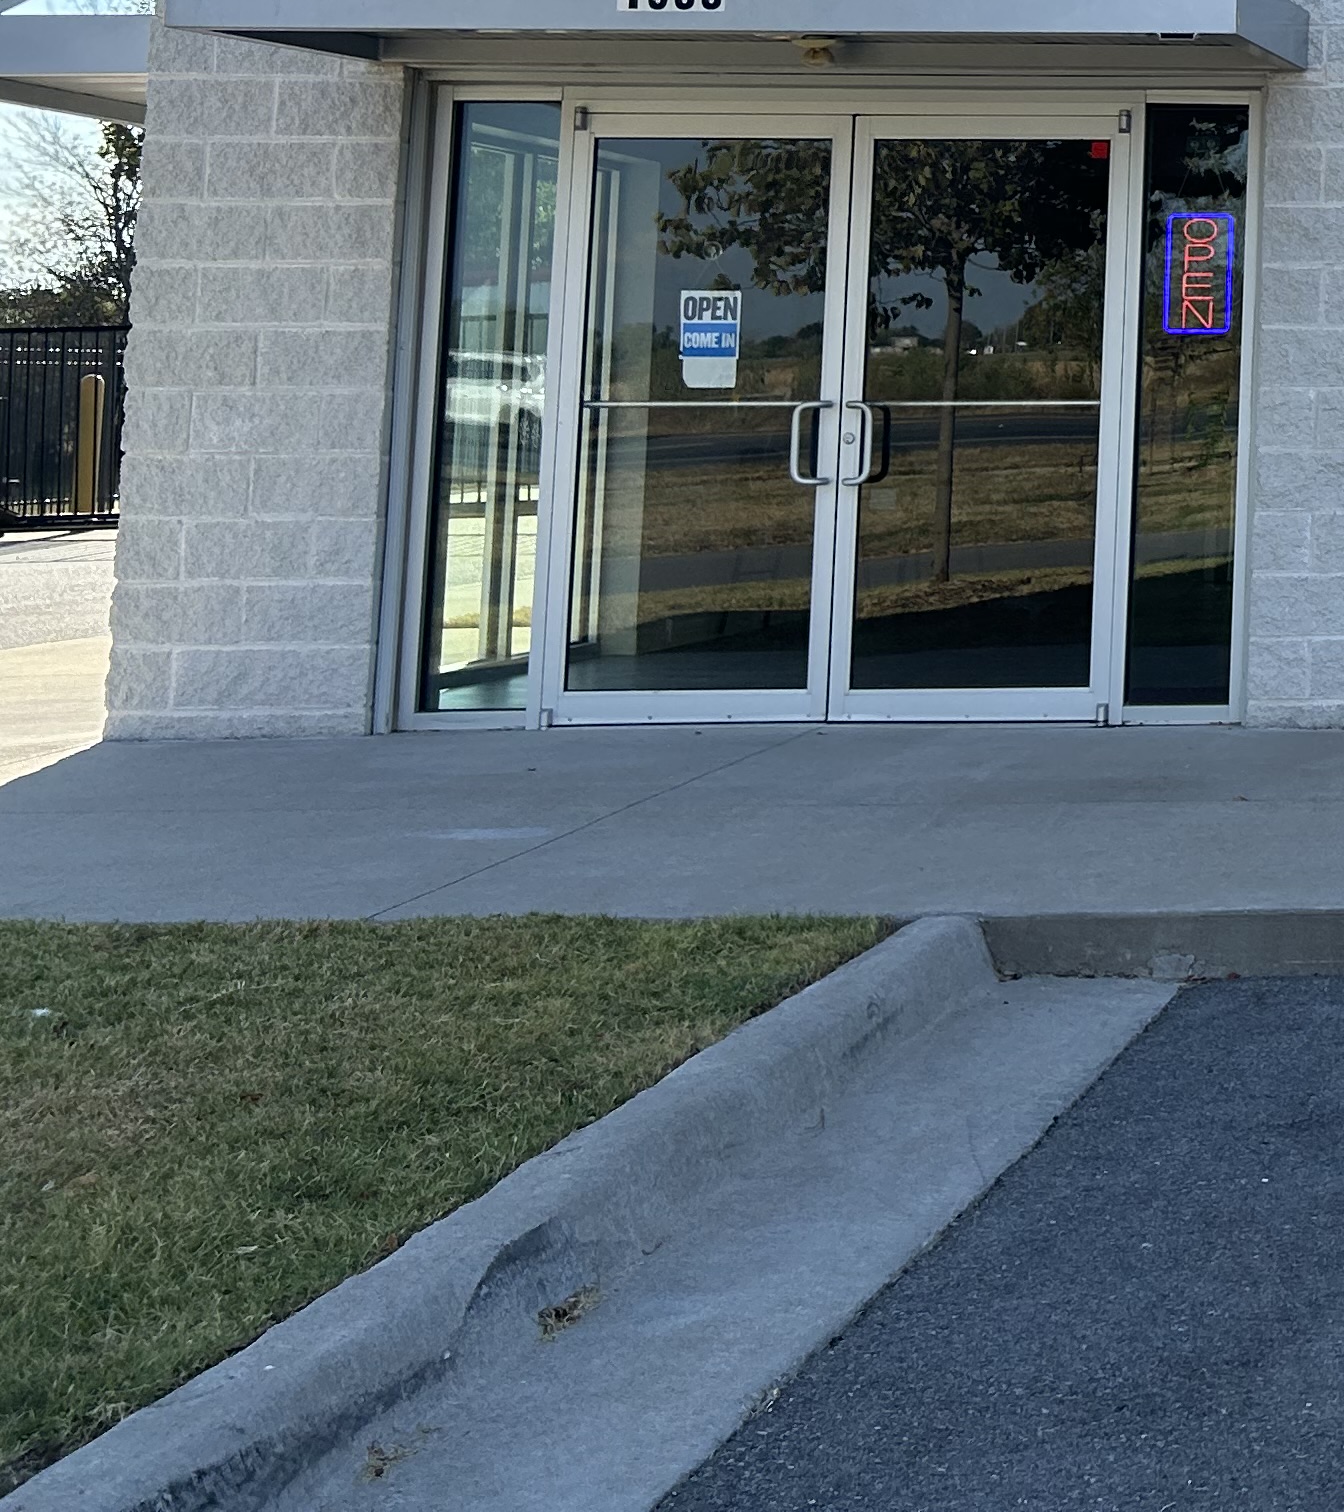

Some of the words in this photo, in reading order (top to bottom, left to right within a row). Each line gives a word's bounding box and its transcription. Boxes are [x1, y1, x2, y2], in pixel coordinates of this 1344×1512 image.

[1182, 217, 1218, 329] OPEN
[683, 296, 738, 321] OPEN
[684, 332, 719, 348] COME
[721, 332, 736, 348] IN
